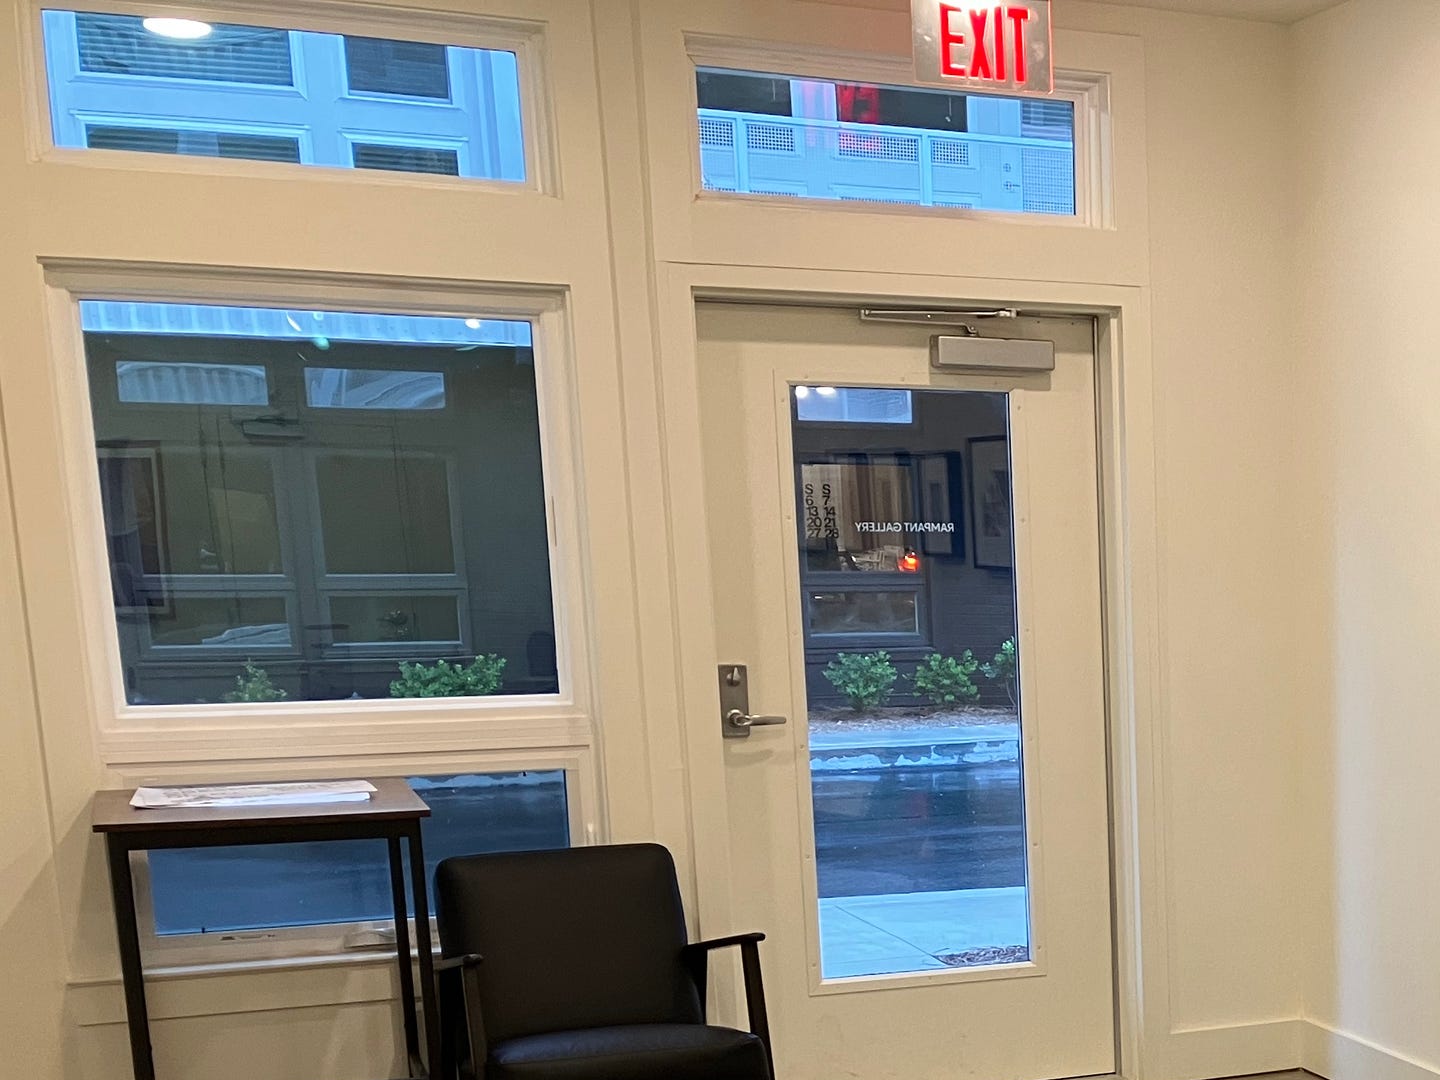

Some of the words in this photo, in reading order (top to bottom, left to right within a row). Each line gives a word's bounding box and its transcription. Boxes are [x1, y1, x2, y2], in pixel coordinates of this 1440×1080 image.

[939, 3, 1029, 83] EXIT
[805, 483, 814, 494] S
[822, 484, 831, 495] S
[805, 495, 814, 506] 6
[822, 495, 830, 506] 7
[806, 506, 819, 517] 13
[823, 506, 836, 517] 14
[807, 516, 822, 528] 20
[824, 517, 836, 528] 21
[807, 527, 822, 538] 27
[824, 527, 839, 539] 28
